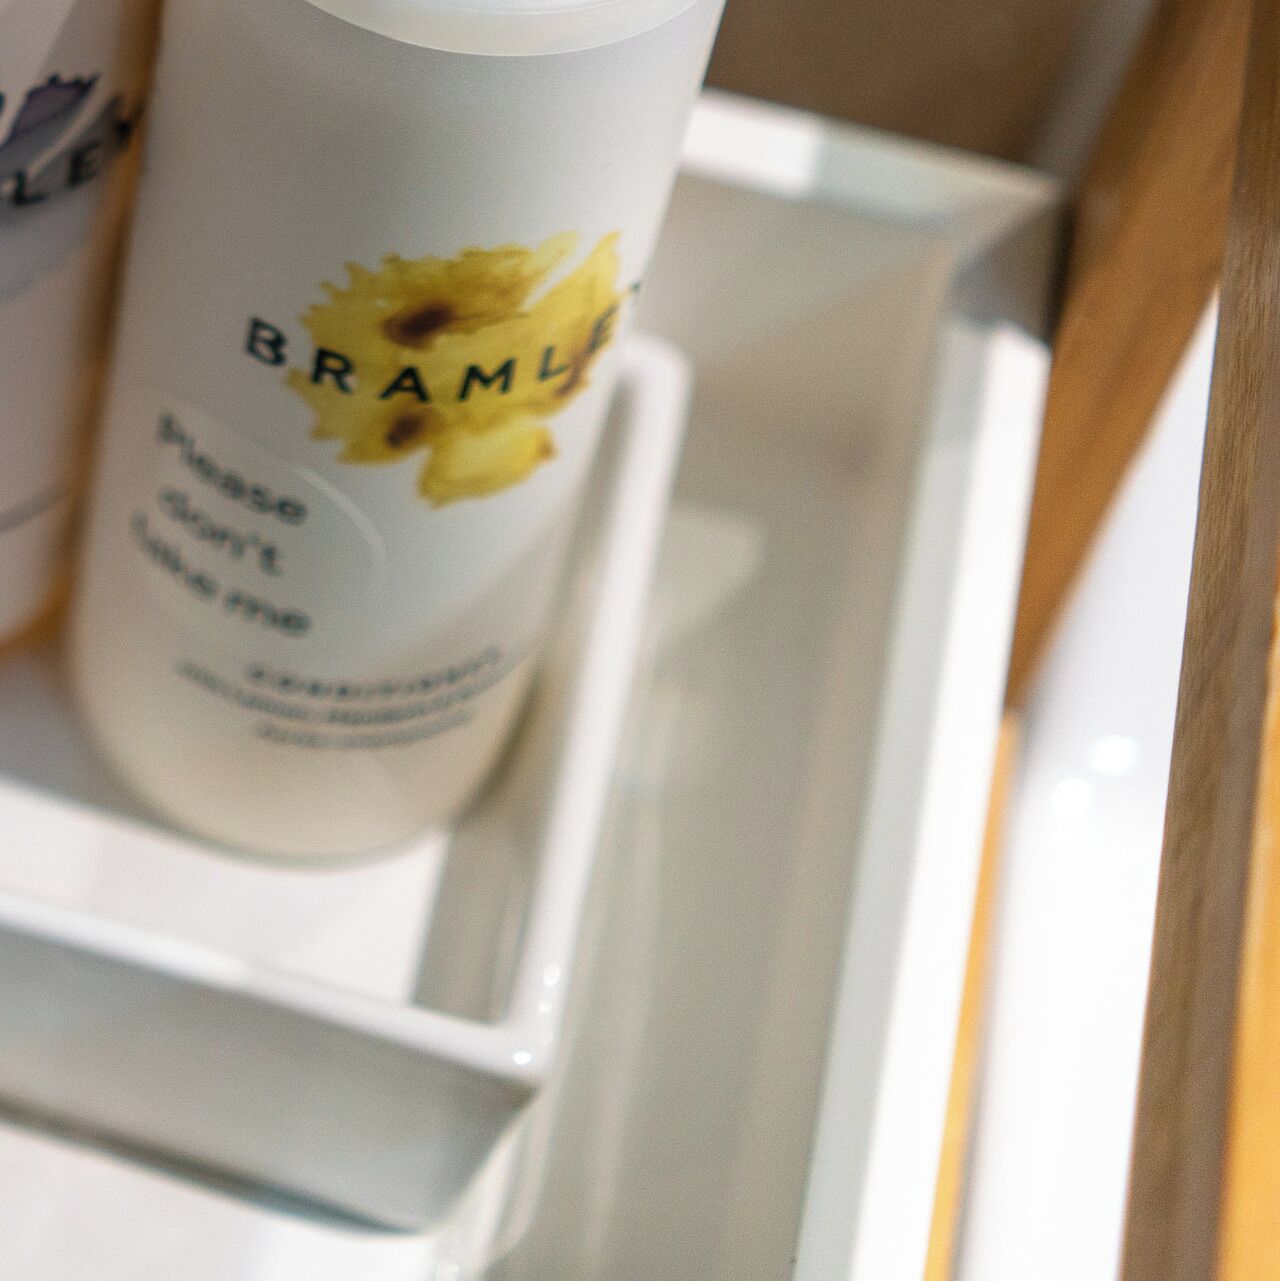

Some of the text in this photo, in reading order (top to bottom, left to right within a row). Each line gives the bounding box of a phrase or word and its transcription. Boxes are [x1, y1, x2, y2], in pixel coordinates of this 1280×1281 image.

[158, 414, 309, 526] Please
[159, 487, 283, 577] don't
[224, 587, 312, 638] me
